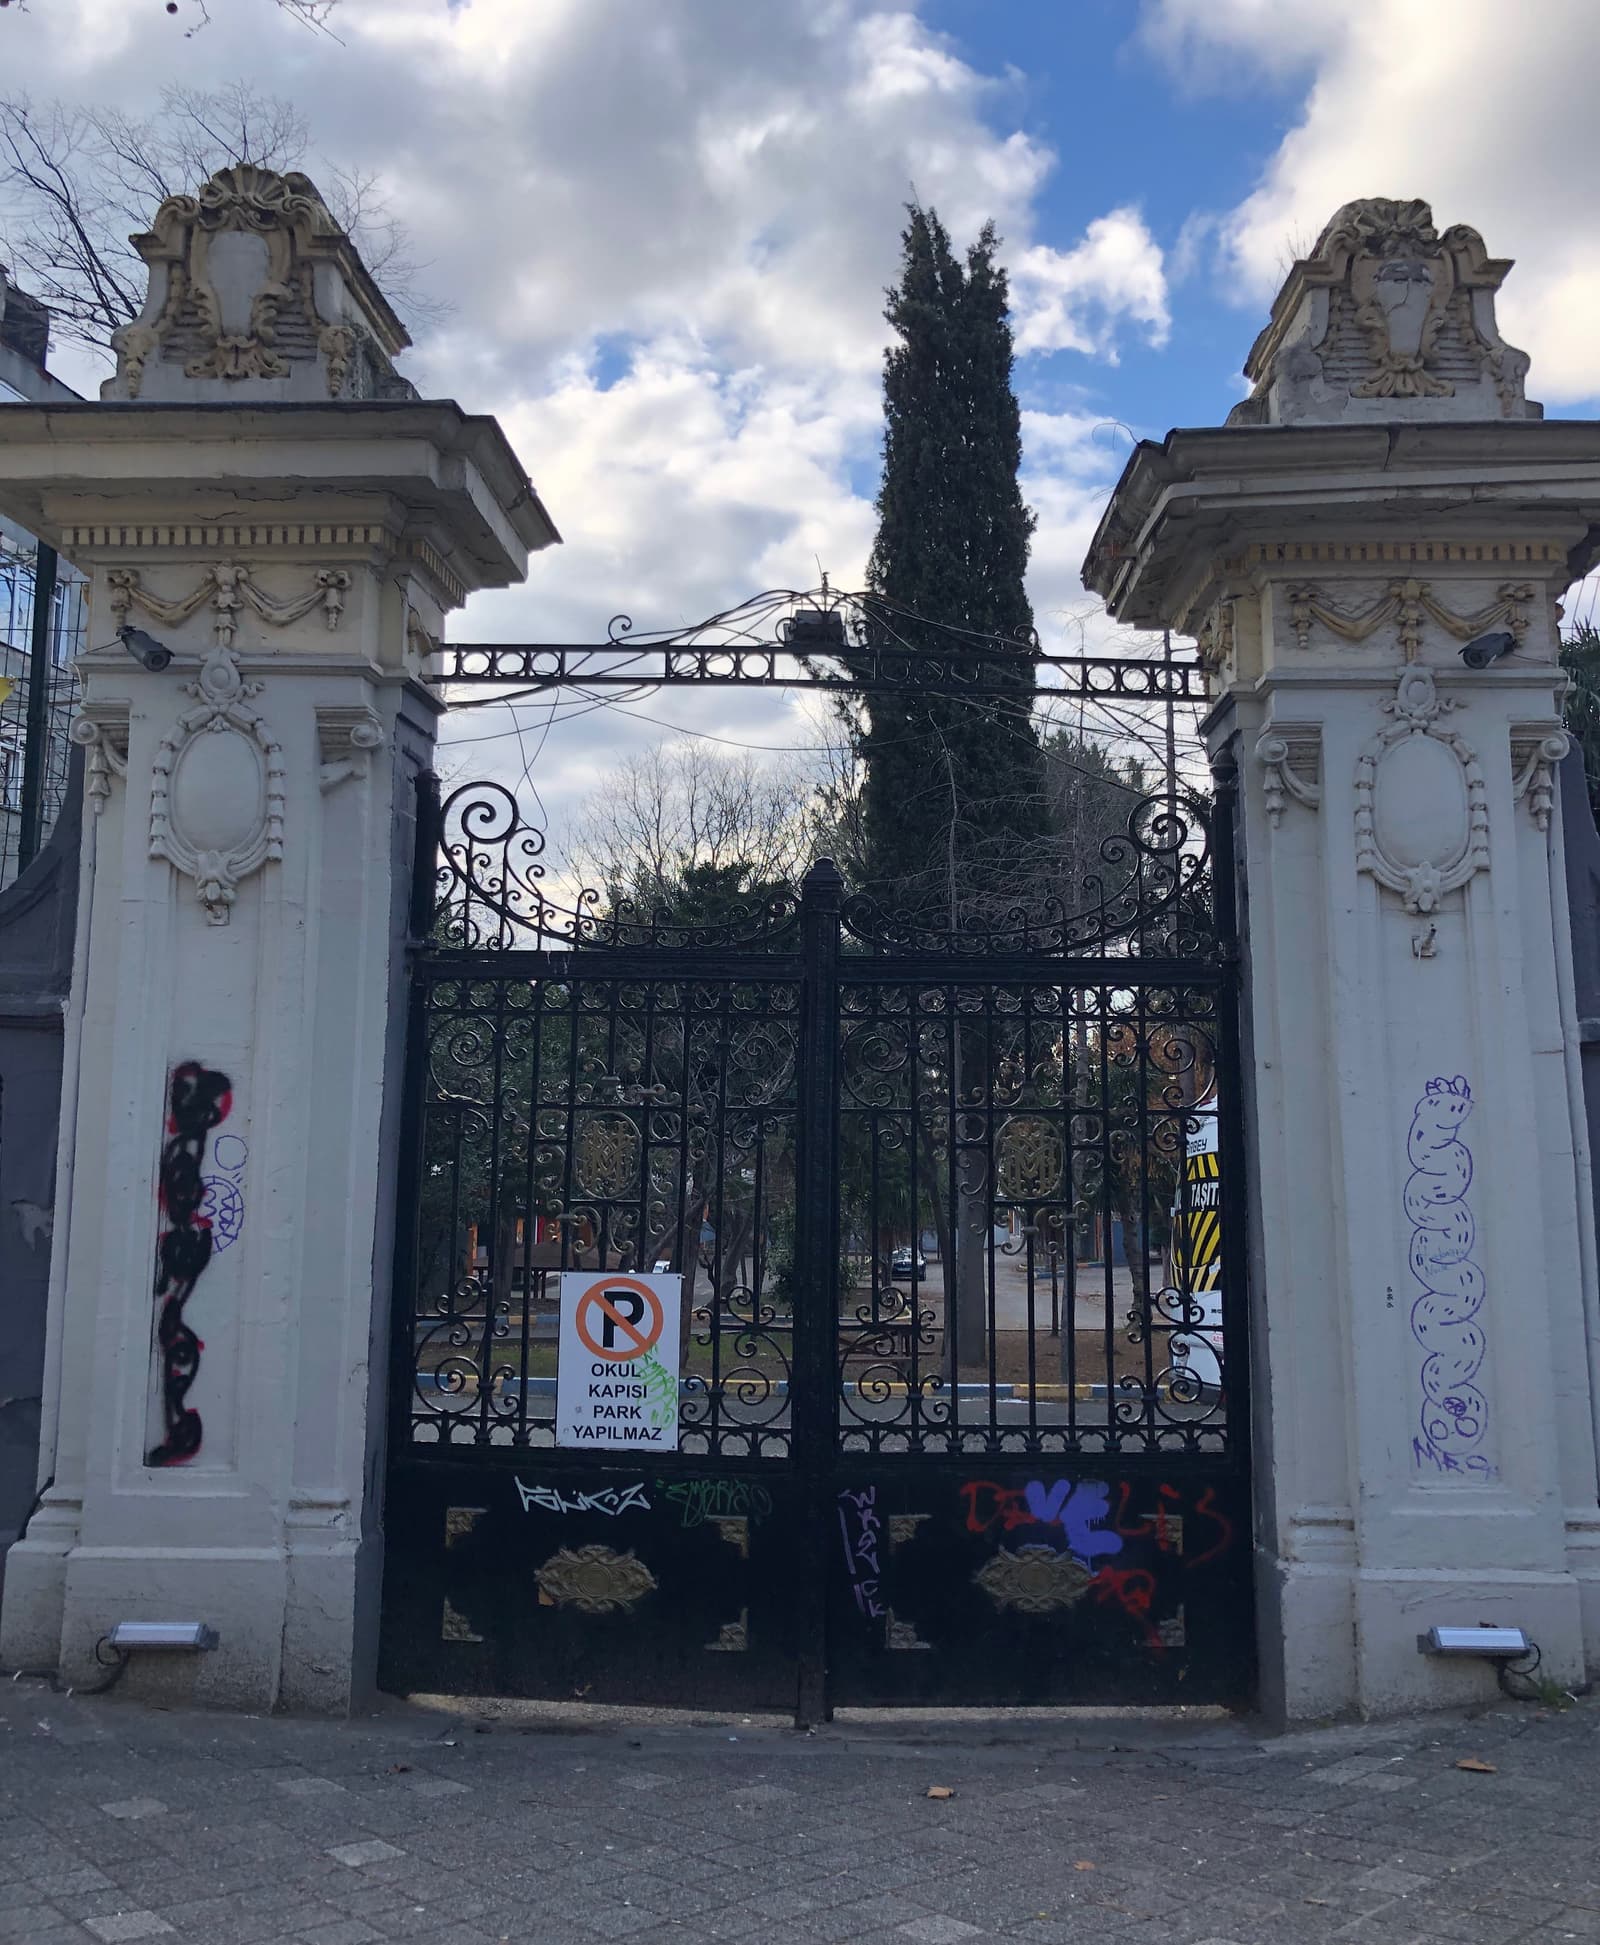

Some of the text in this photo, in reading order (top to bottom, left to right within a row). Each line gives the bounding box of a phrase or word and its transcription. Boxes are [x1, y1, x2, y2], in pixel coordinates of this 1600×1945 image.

[591, 1363, 641, 1378] OKUL
[589, 1384, 647, 1399] KAPISI
[593, 1405, 642, 1419] PARK
[572, 1425, 662, 1441] YAPILMAZ
